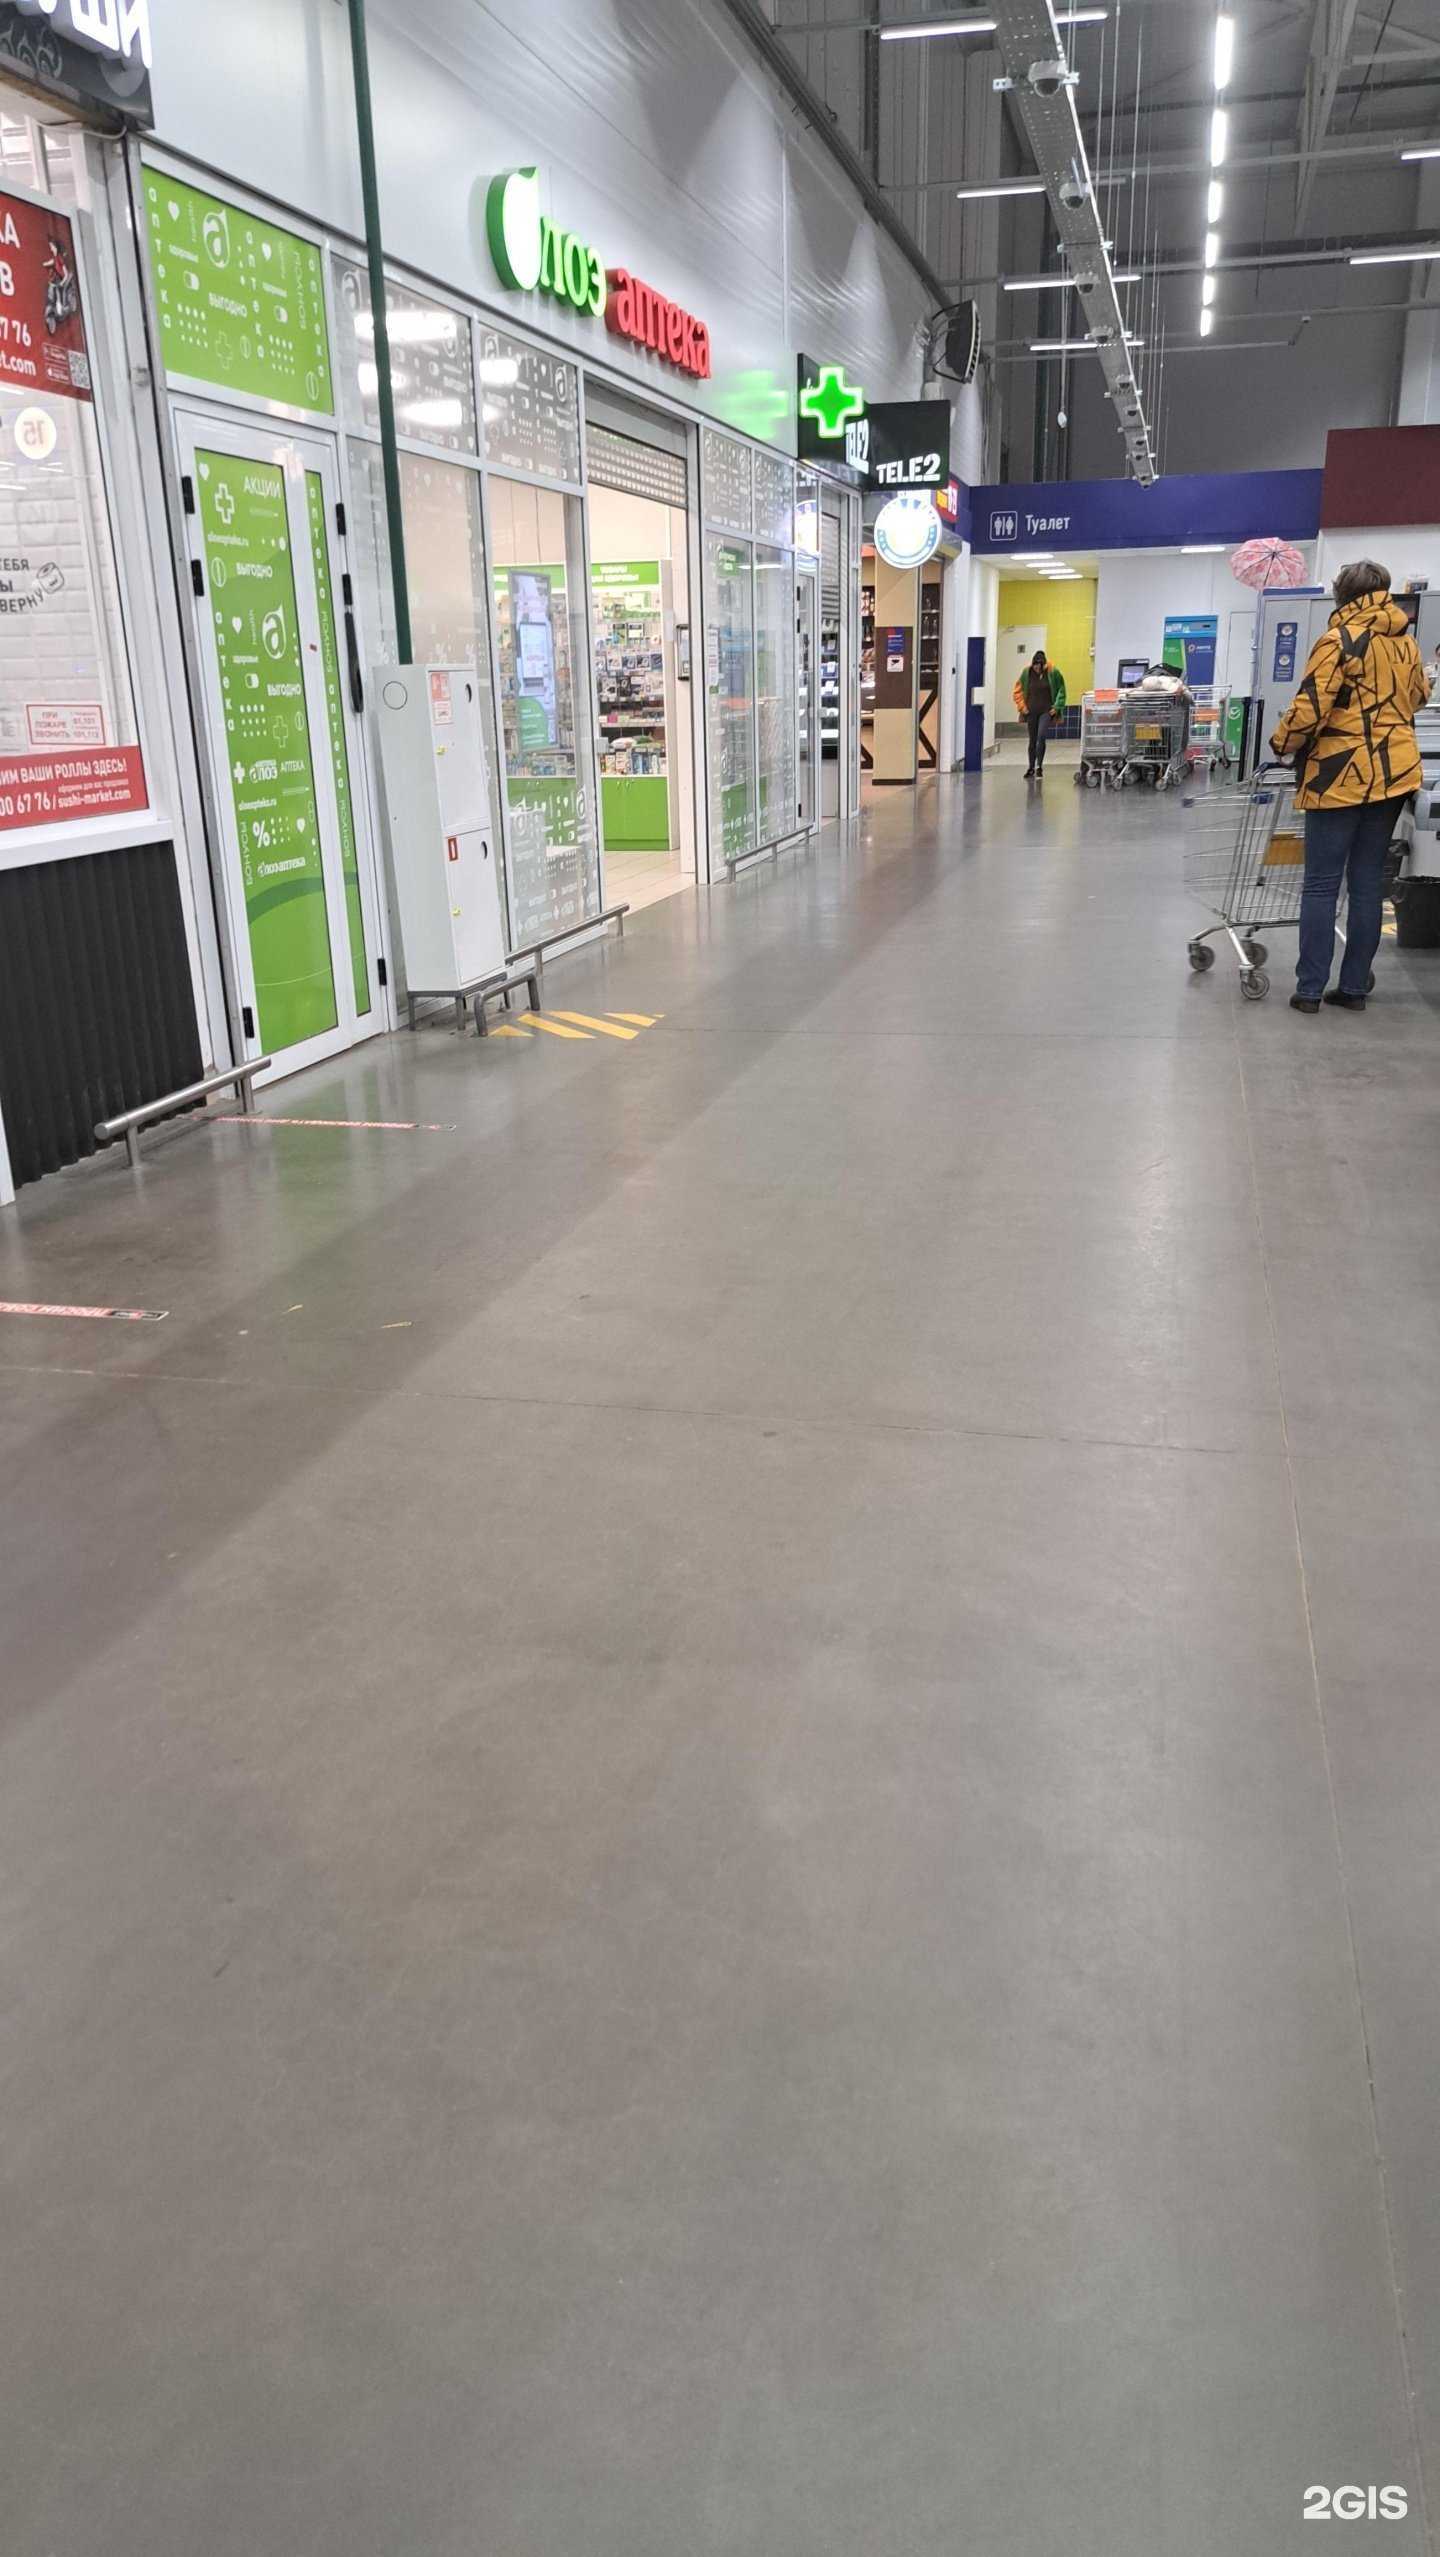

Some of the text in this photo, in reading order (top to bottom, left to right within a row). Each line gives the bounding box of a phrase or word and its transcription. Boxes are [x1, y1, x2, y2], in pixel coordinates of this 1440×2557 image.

[39, 0, 152, 69] ШИ
[11, 319, 32, 347] 76
[605, 268, 712, 379] аптека
[876, 453, 941, 484] TELE2
[243, 476, 281, 499] АКЦИИ
[1025, 514, 1071, 536] Туалет
[0, 757, 127, 784] ИМ ВАШИ РОЛЛЫ ЗДЕСЬ!
[17, 793, 32, 814] 67
[34, 790, 51, 812] 76
[58, 788, 132, 809] sushi-market.com
